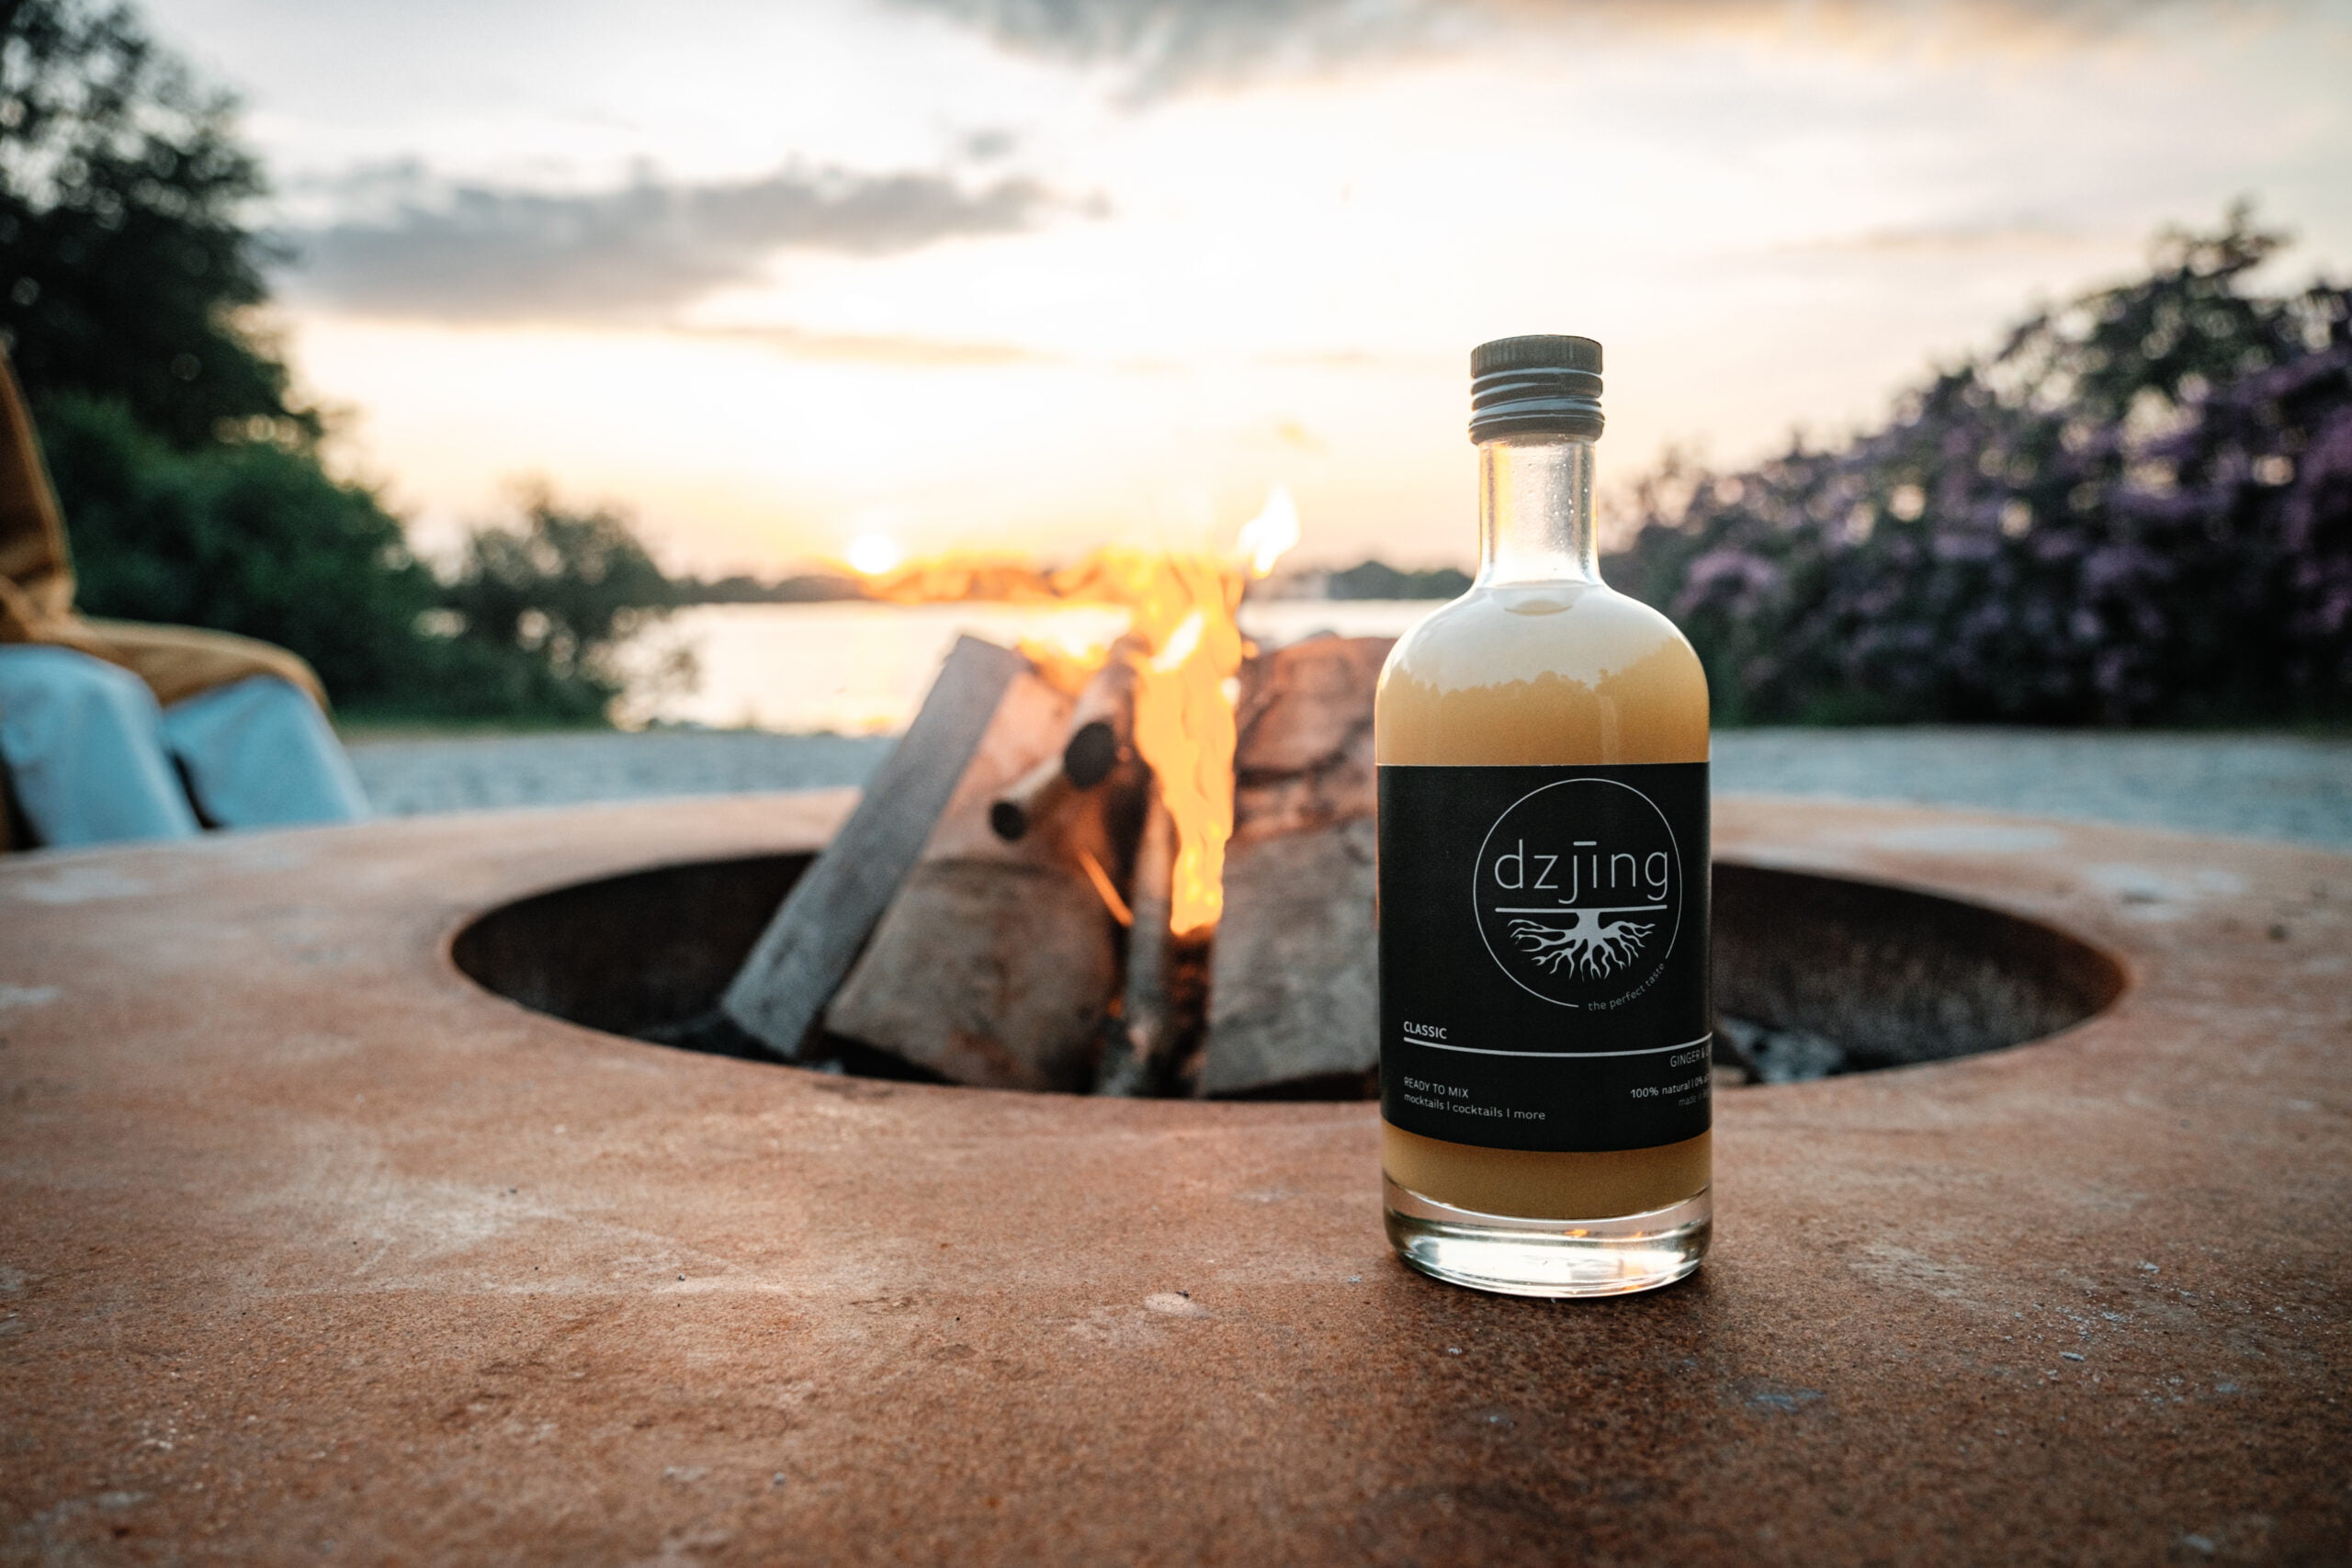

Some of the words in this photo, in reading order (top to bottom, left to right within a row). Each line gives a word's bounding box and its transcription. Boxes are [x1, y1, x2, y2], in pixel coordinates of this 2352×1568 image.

[1588, 1001, 1607, 1011] the
[1610, 986, 1646, 1010] perfect
[1645, 963, 1665, 987] taste
[1403, 1021, 1447, 1040] CLASSIC
[1670, 1049, 1701, 1067] GINGER
[1404, 1077, 1430, 1091] READY
[1433, 1083, 1445, 1095] TO
[1448, 1087, 1469, 1099] MIX
[1630, 1086, 1659, 1099] 100%
[1662, 1080, 1690, 1095] natural
[1404, 1093, 1444, 1110] mocktails
[1453, 1104, 1503, 1118] cocktails
[1514, 1111, 1546, 1121] more
